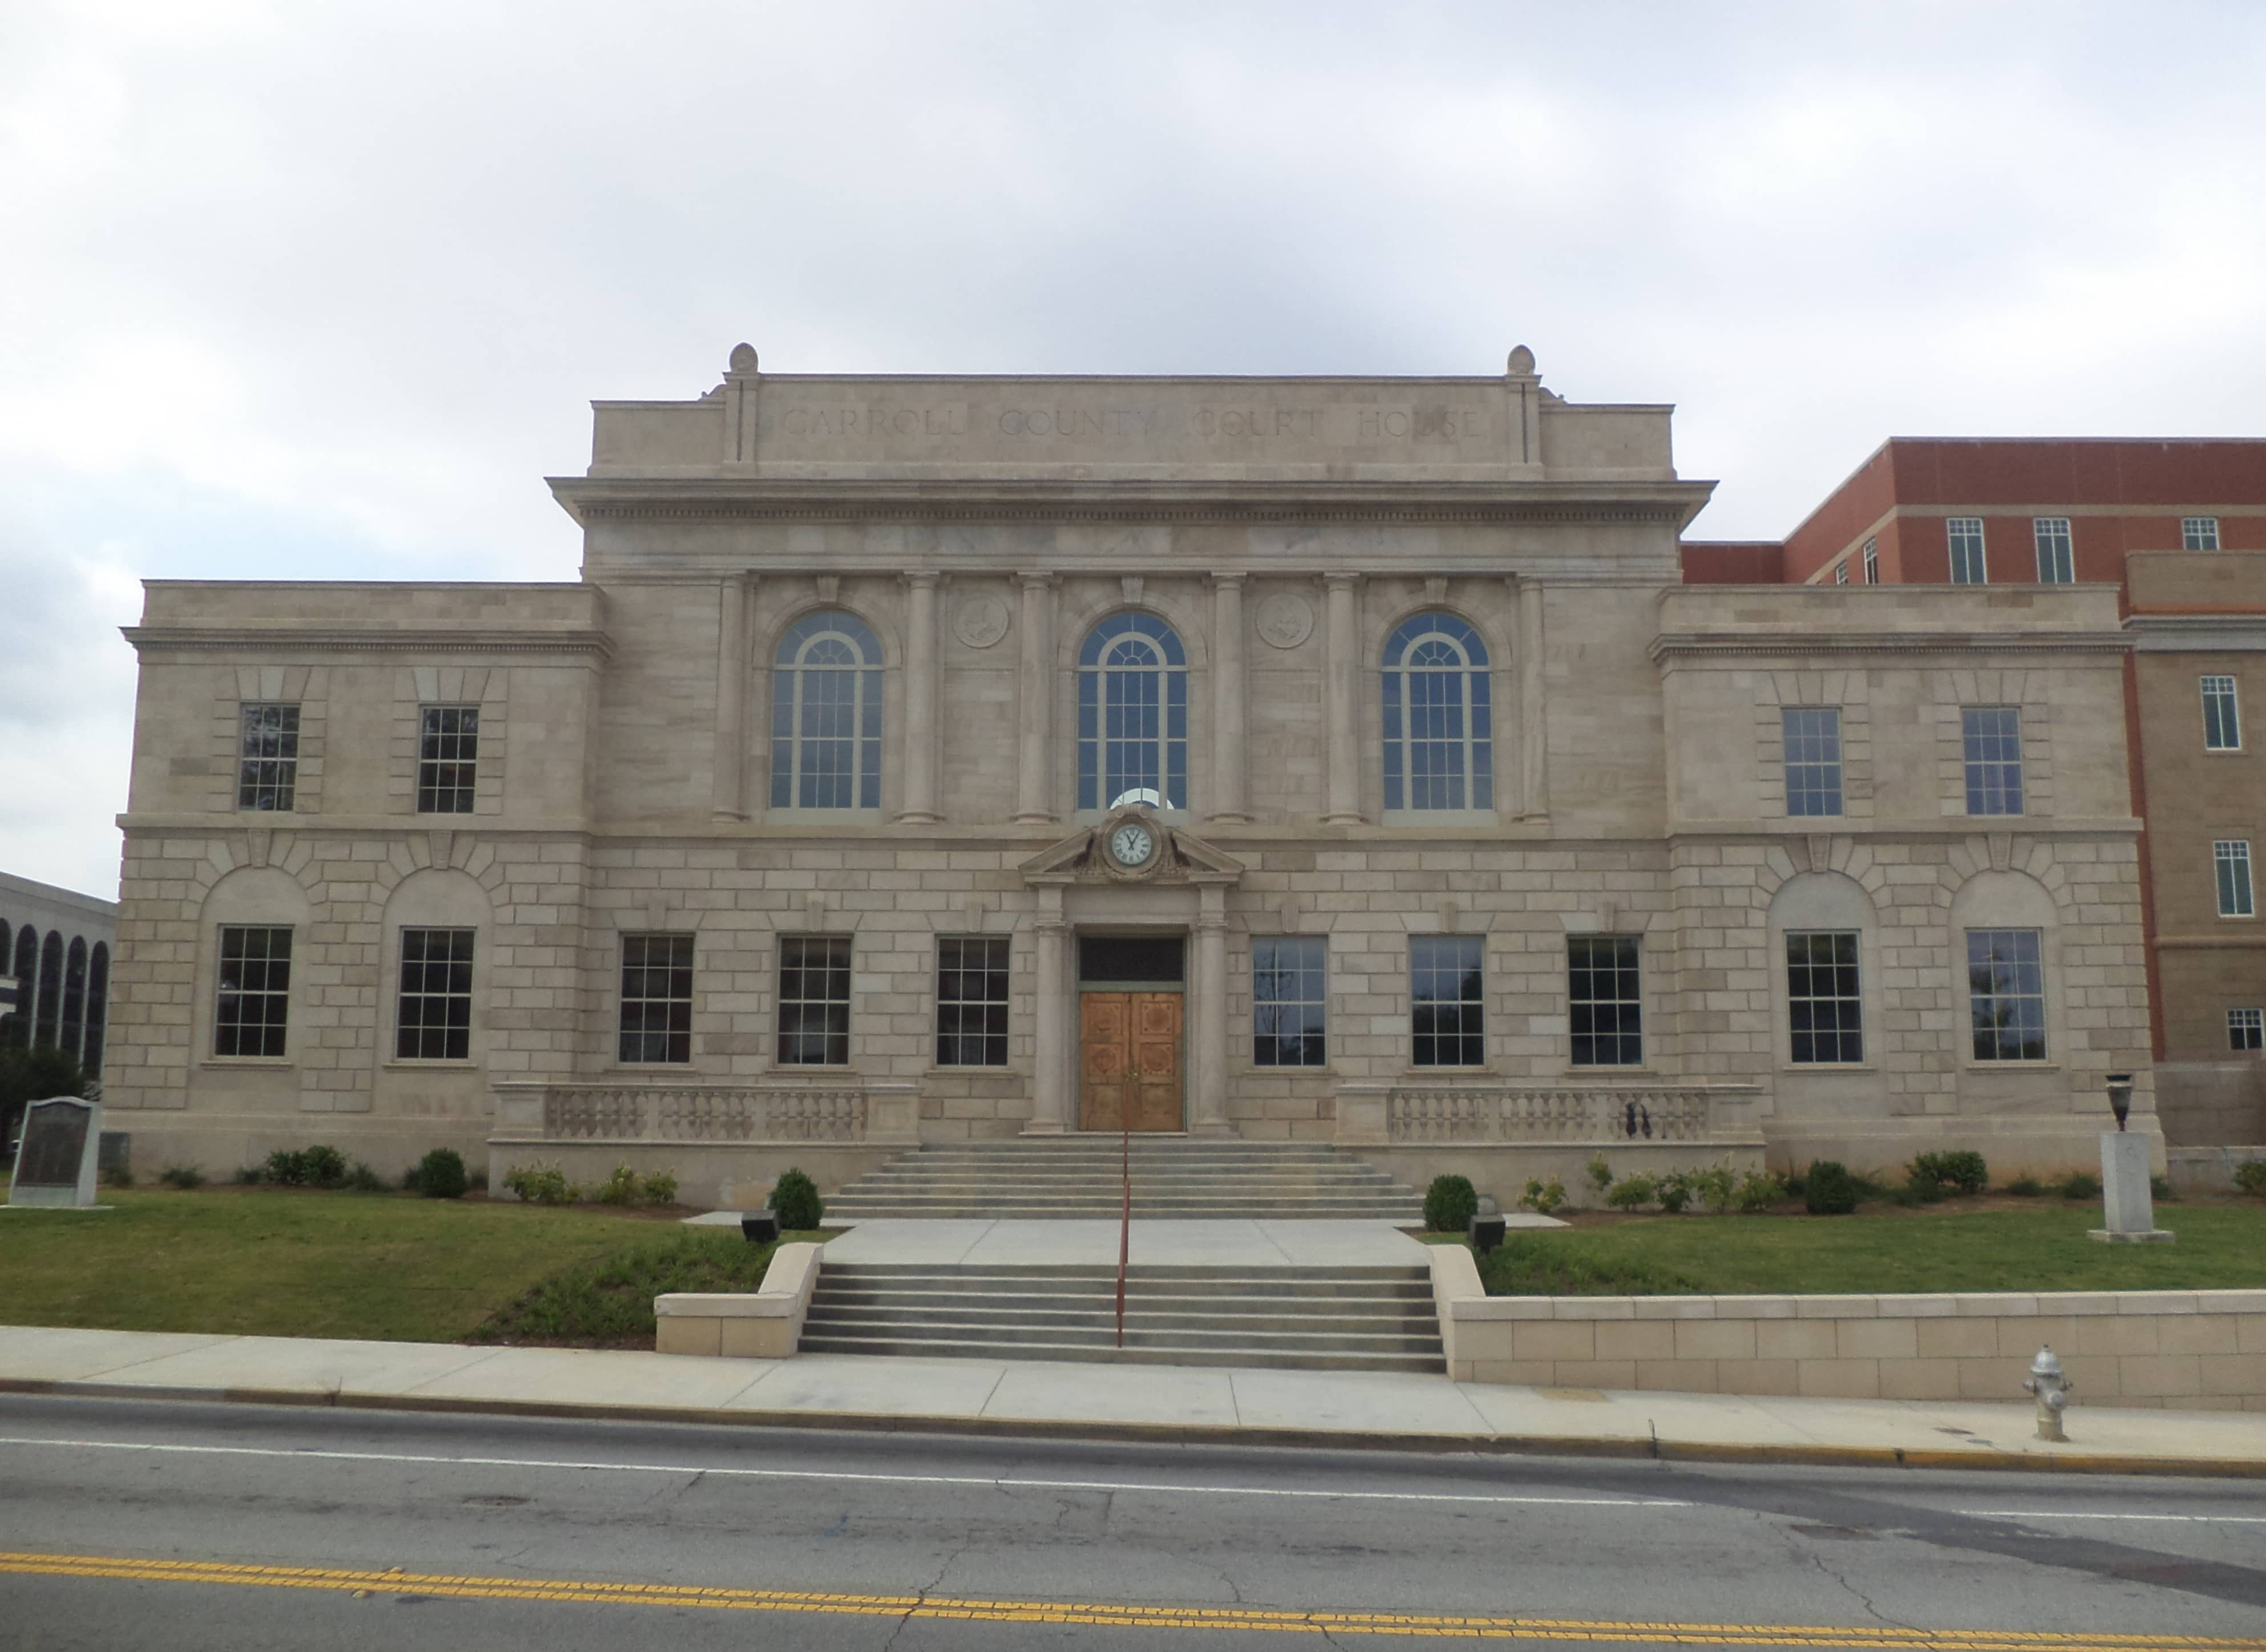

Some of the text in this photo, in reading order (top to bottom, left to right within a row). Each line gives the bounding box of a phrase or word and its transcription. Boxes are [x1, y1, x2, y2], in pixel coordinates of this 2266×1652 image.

[782, 408, 1480, 438] CARROLL COUNTY COURT HOUSE
